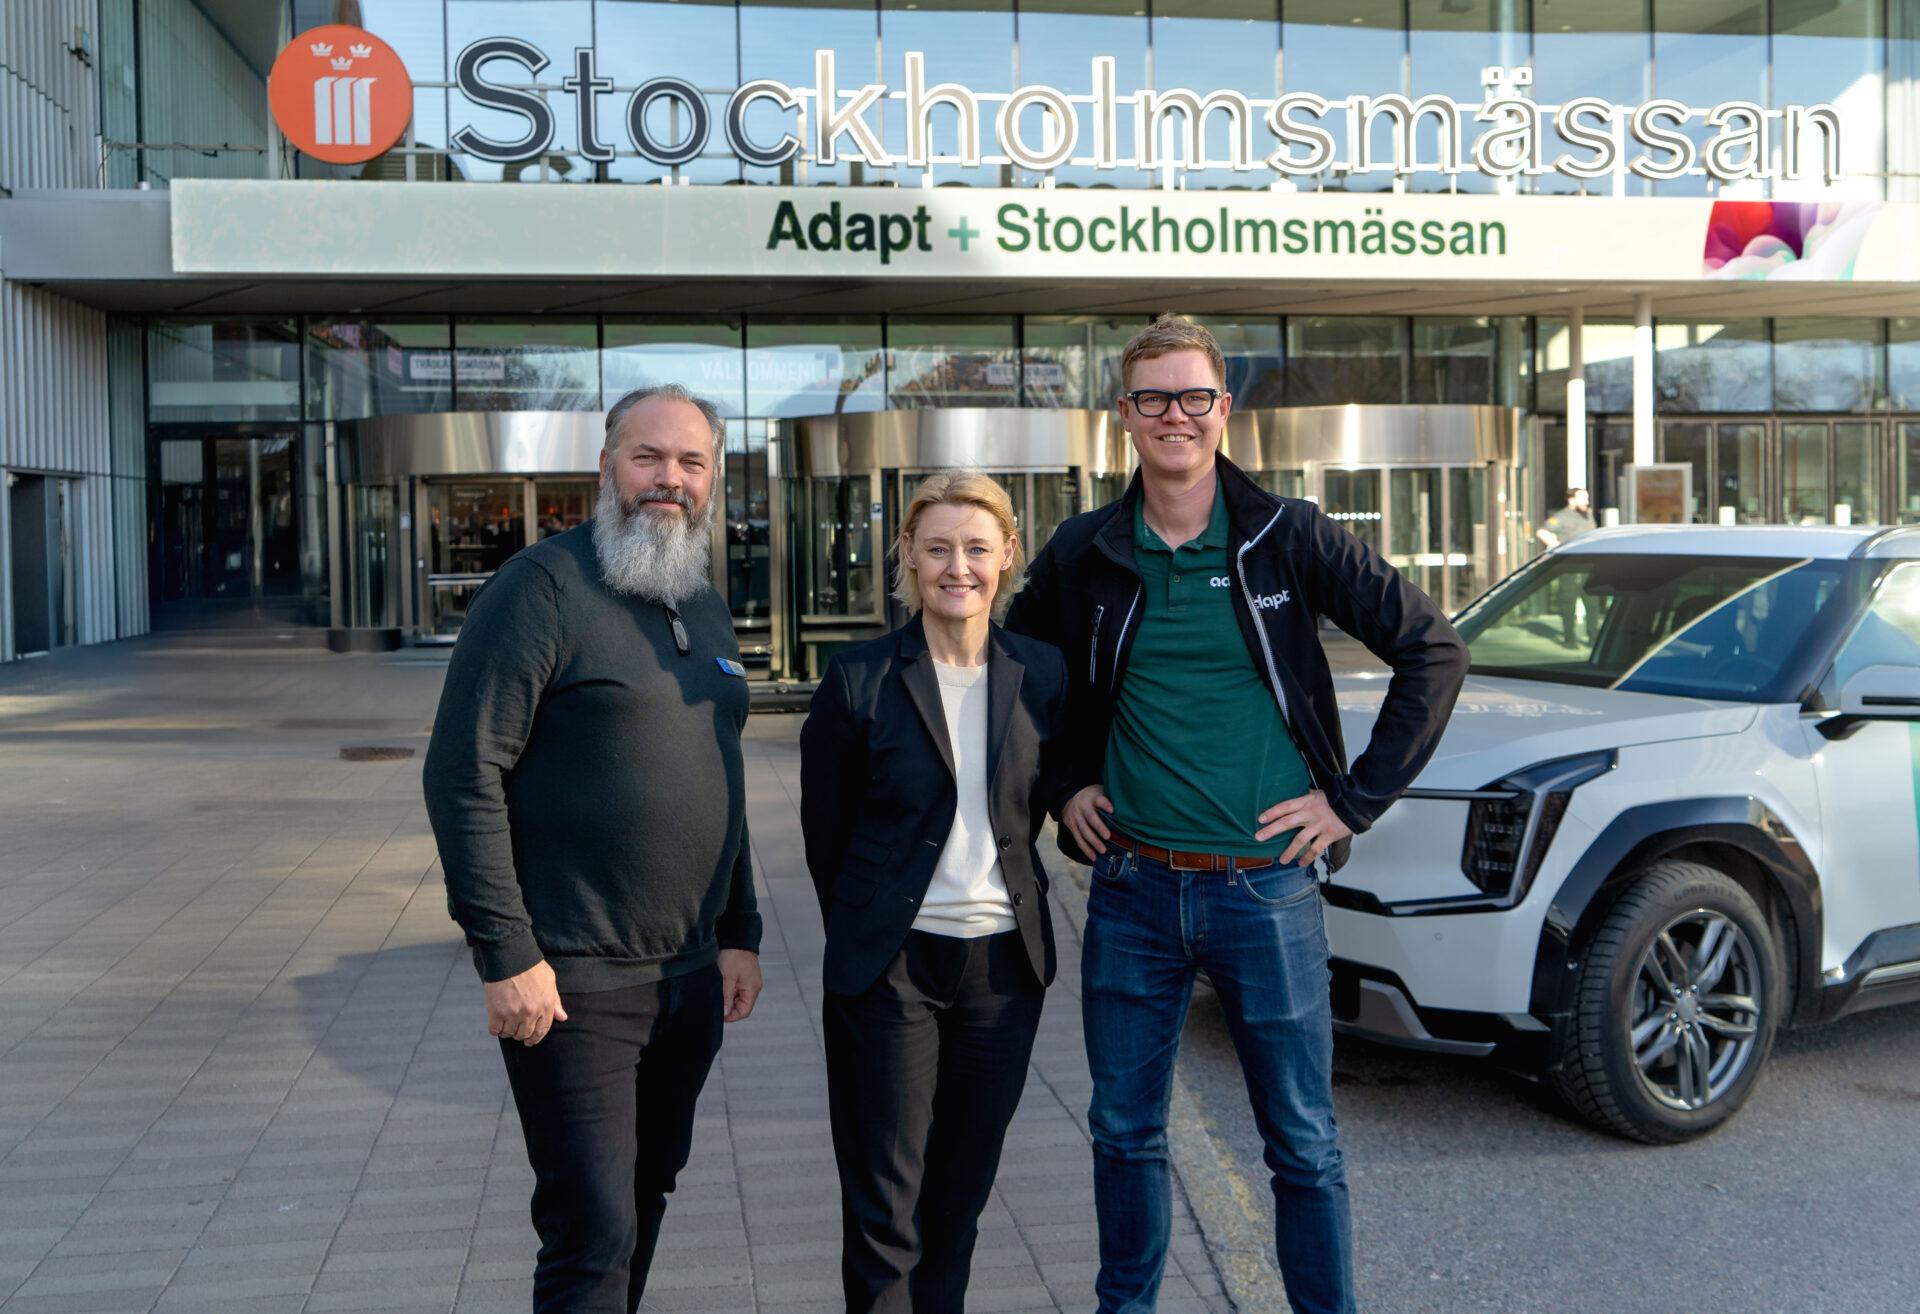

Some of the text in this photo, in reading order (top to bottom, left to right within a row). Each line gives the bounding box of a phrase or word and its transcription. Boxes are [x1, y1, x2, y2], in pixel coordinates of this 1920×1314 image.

[453, 37, 1846, 181] Stockholmsmässan
[766, 200, 932, 264] Adapt
[996, 203, 1506, 254] Stockholmsmässan
[1254, 589, 1290, 610] dapt
